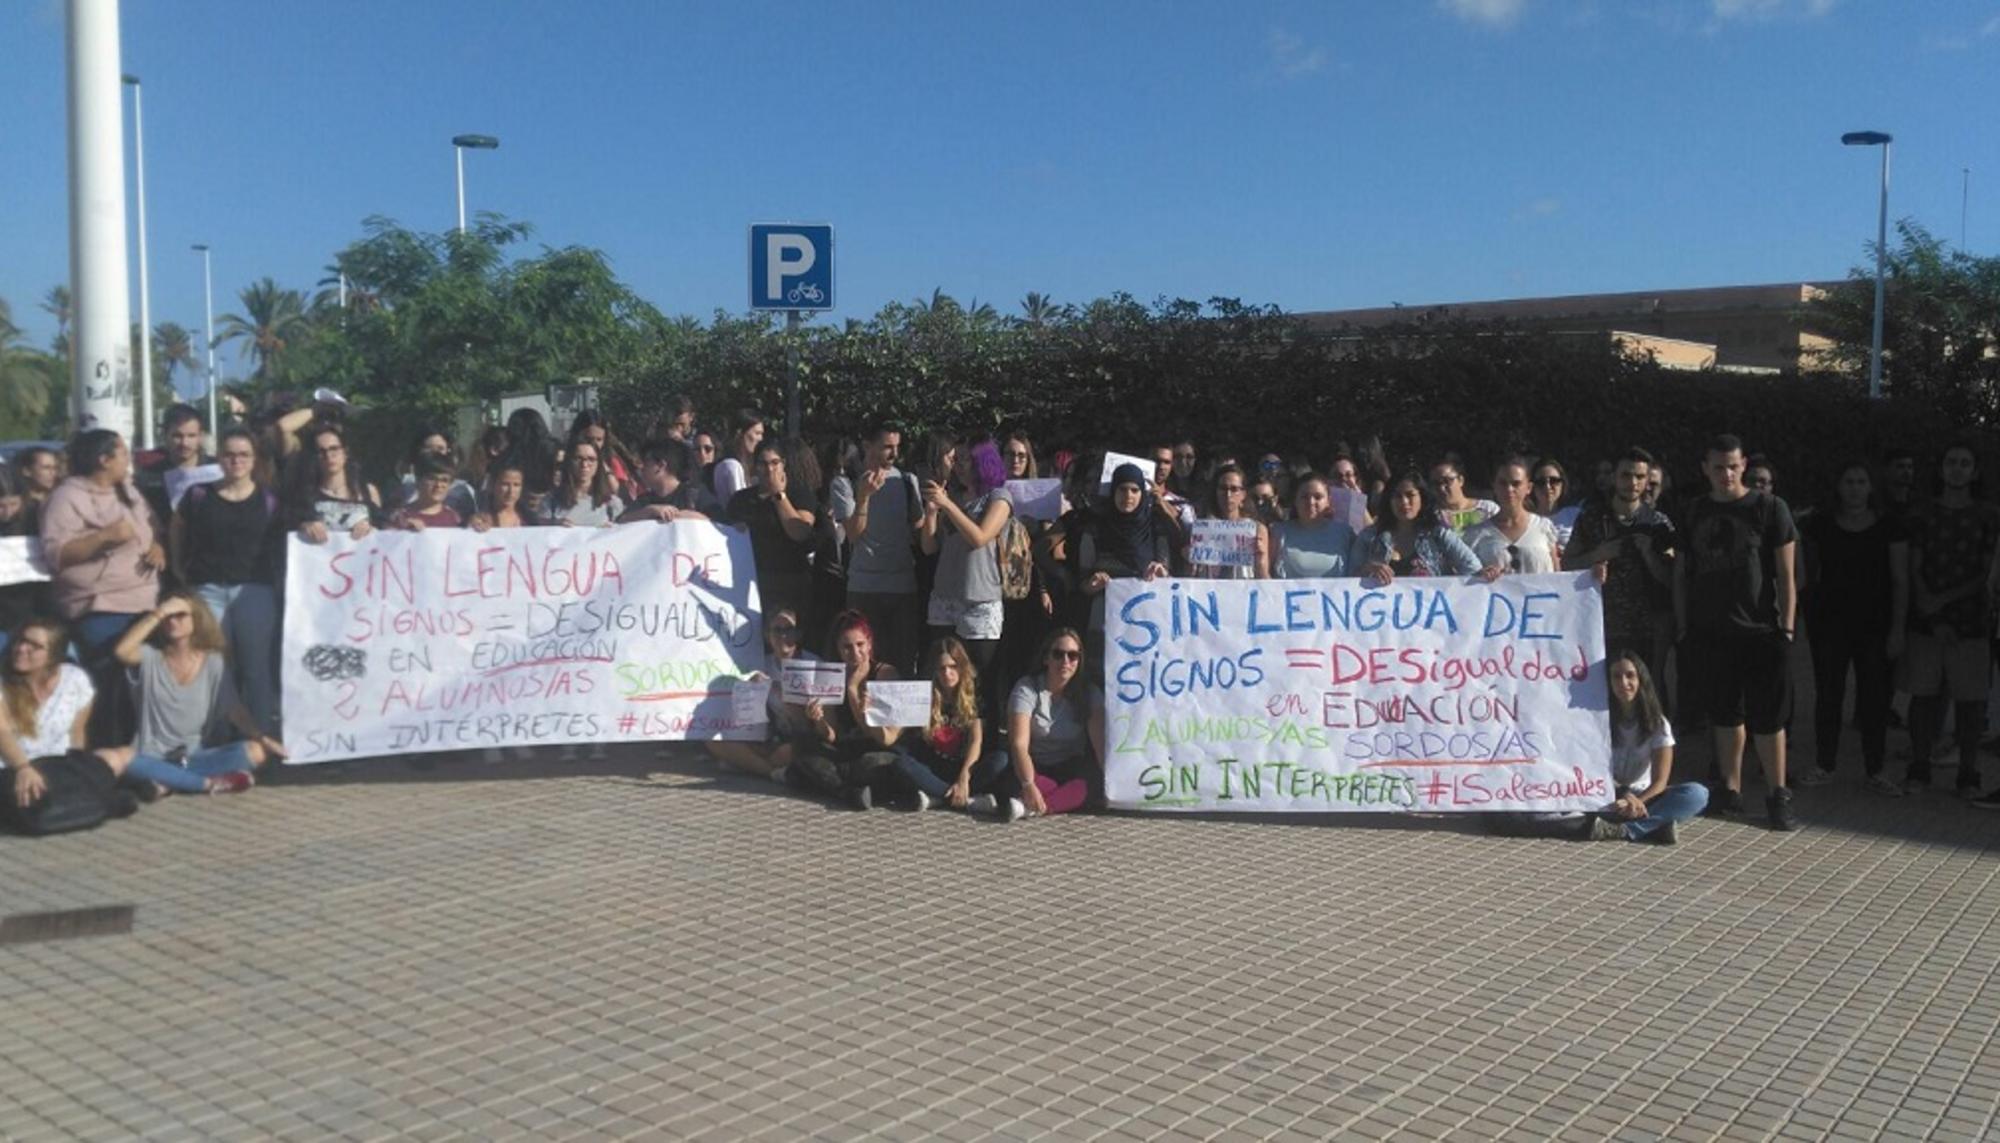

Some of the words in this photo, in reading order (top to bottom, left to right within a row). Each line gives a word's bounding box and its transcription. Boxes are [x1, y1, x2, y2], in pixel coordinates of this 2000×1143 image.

[767, 233, 816, 300] P
[444, 544, 623, 599] LENGUA
[672, 553, 722, 588] DE
[1247, 588, 1458, 635] LENGUA
[1484, 592, 1563, 640] DE
[388, 645, 434, 673] EN
[381, 666, 595, 717] ALUMNOS/AS
[1266, 692, 1309, 718] en
[1344, 725, 1542, 764] SORDOS/AS
